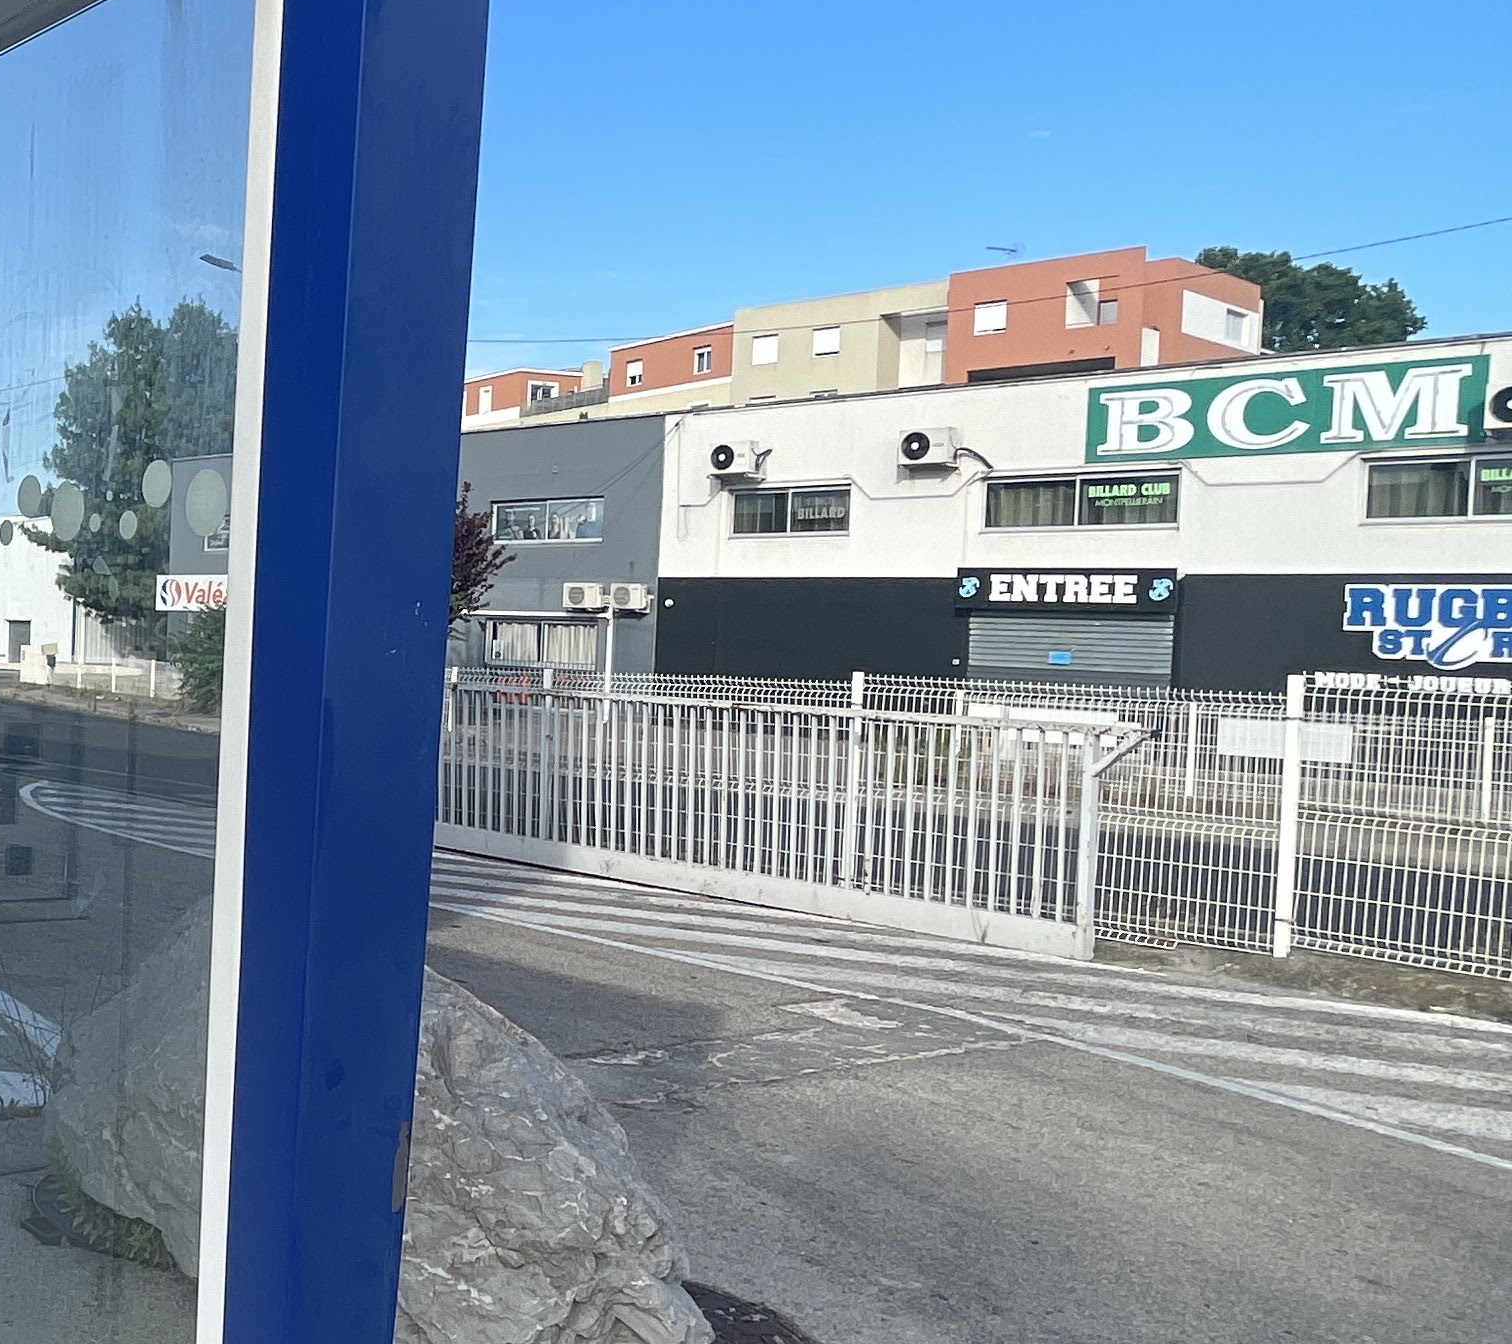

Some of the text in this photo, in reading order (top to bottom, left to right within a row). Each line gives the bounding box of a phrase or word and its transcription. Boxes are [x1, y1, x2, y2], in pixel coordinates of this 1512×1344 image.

[1095, 363, 1473, 456] BCM
[1088, 482, 1171, 498] BILLARD CLUB
[797, 506, 847, 520] BILLARD
[988, 573, 1139, 605] ENTREE
